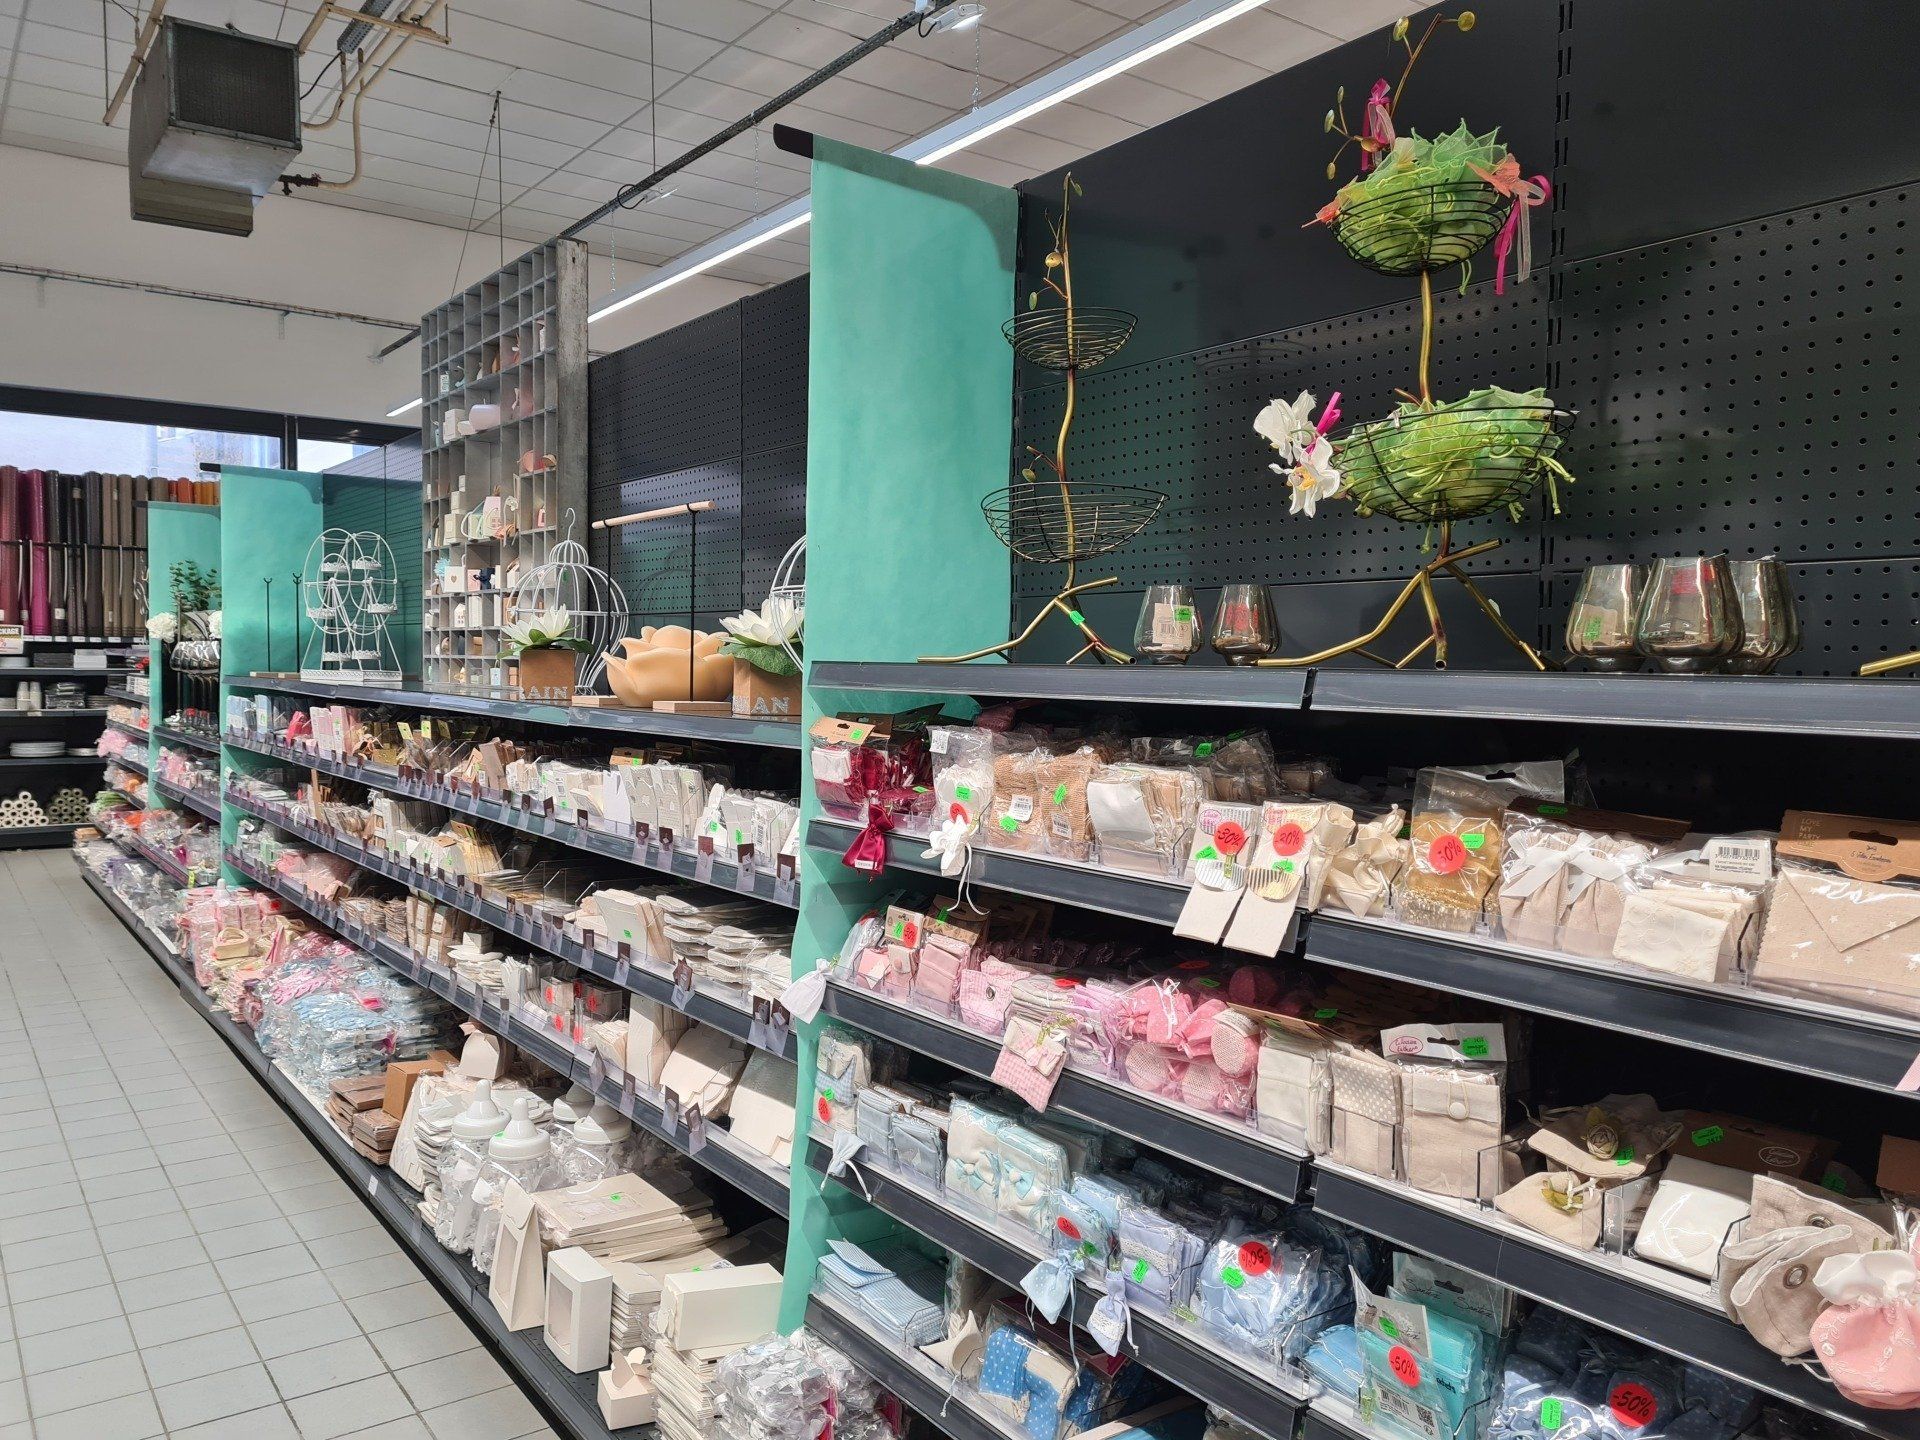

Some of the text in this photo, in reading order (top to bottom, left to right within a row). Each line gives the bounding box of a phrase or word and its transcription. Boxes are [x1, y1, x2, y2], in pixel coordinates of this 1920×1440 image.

[1274, 829, 1301, 847] -20%
[1798, 832, 1822, 840] PARTY
[1799, 825, 1813, 833] MY
[1241, 1247, 1269, 1268] -50%
[1389, 1355, 1417, 1379] -50%
[1612, 1390, 1653, 1418] -50%
